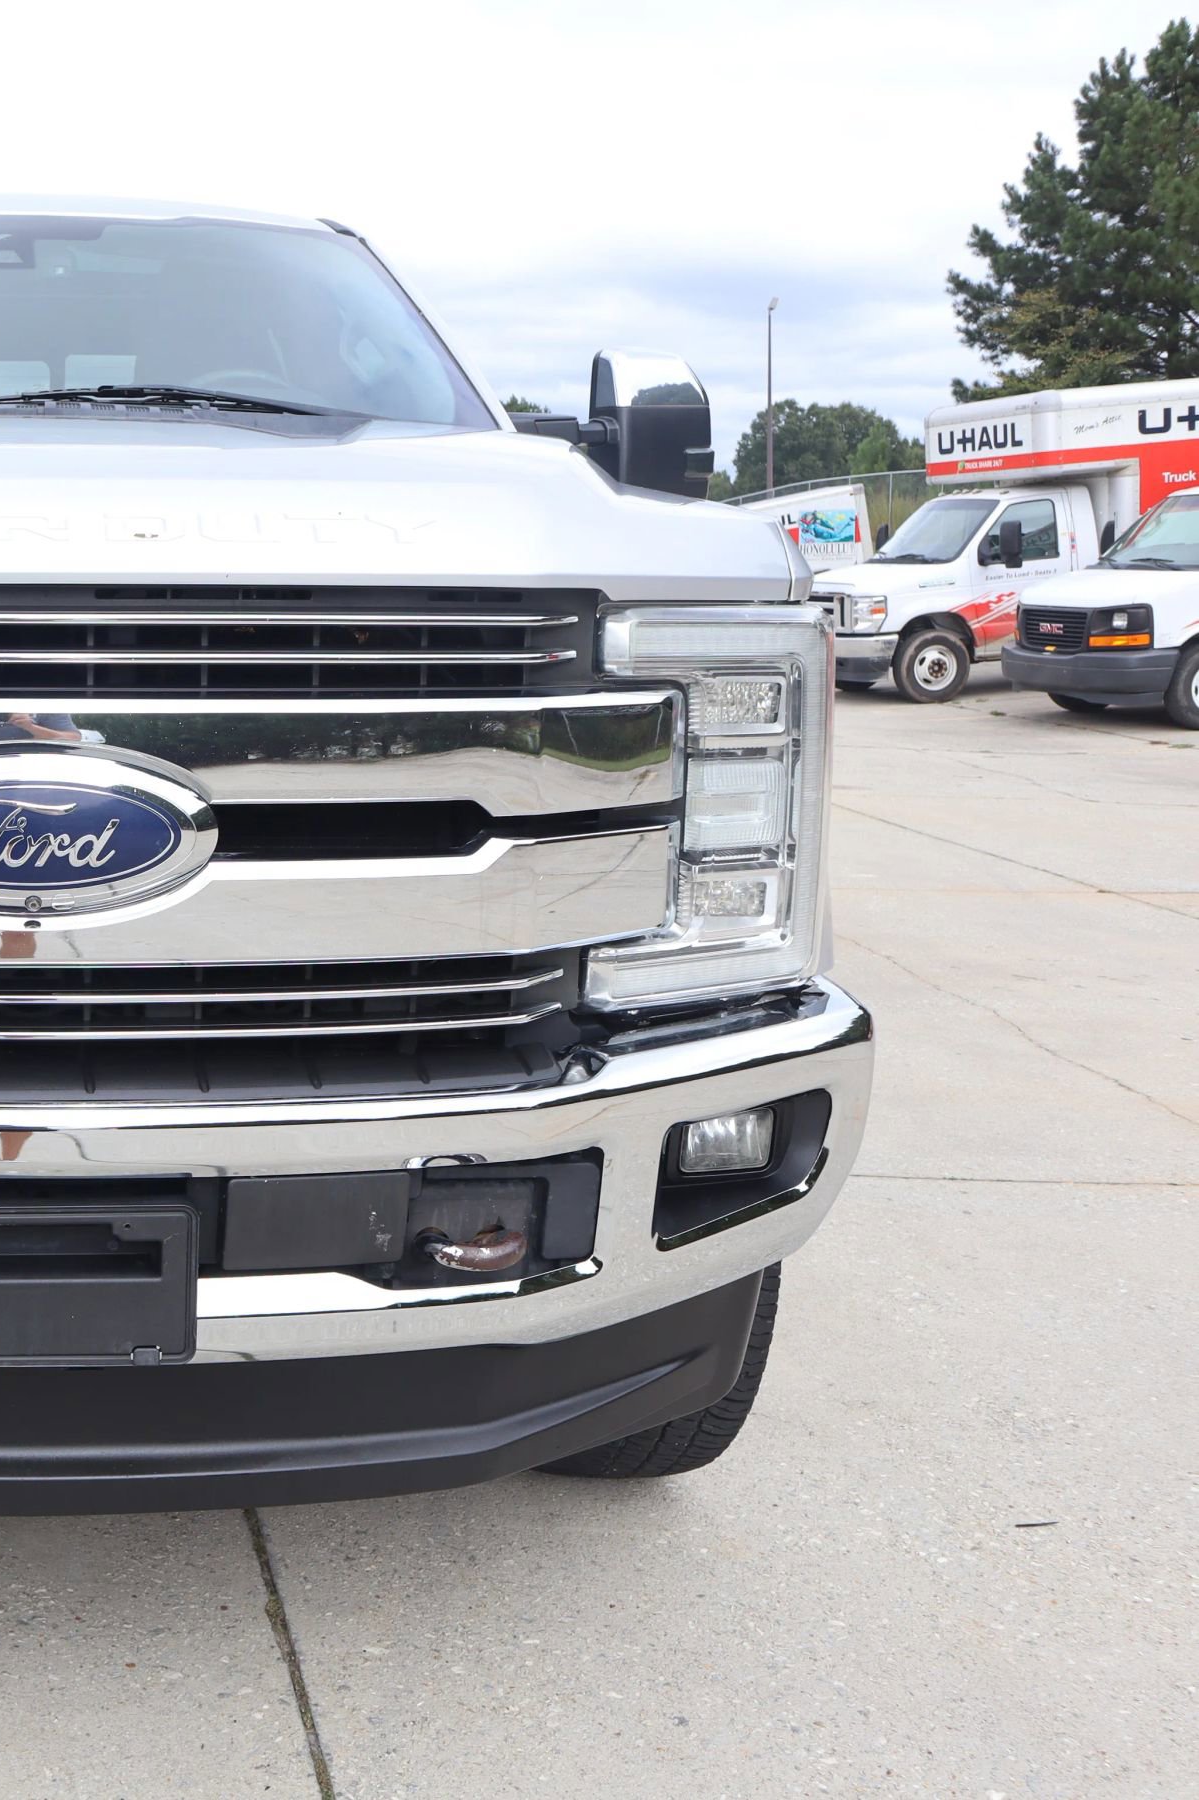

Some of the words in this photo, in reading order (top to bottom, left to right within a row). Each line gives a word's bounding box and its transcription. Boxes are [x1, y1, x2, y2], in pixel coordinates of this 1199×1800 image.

[1162, 470, 1197, 484] Truck
[102, 510, 438, 543] DUTY
[1039, 622, 1064, 635] GMC
